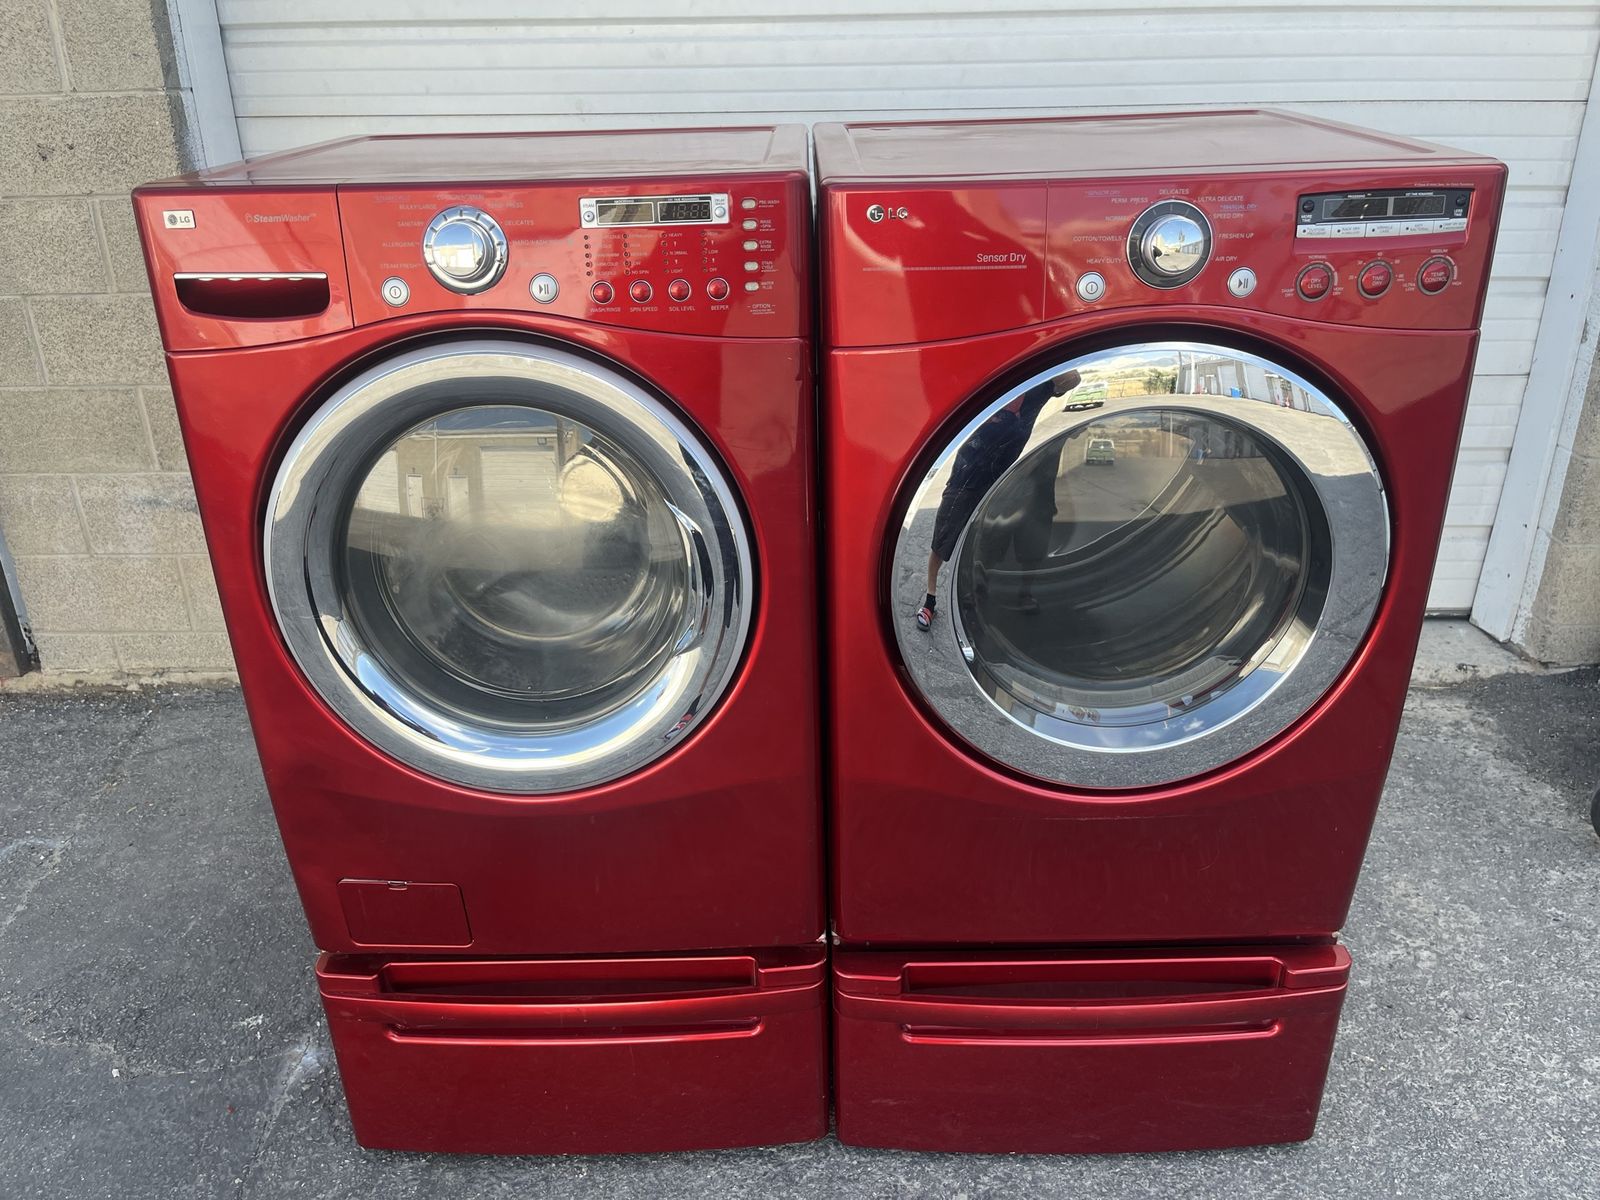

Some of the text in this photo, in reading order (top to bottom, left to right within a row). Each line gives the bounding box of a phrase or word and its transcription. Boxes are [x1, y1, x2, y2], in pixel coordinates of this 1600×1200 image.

[888, 207, 909, 220] LG
[976, 252, 1027, 264] Sensor Dry
